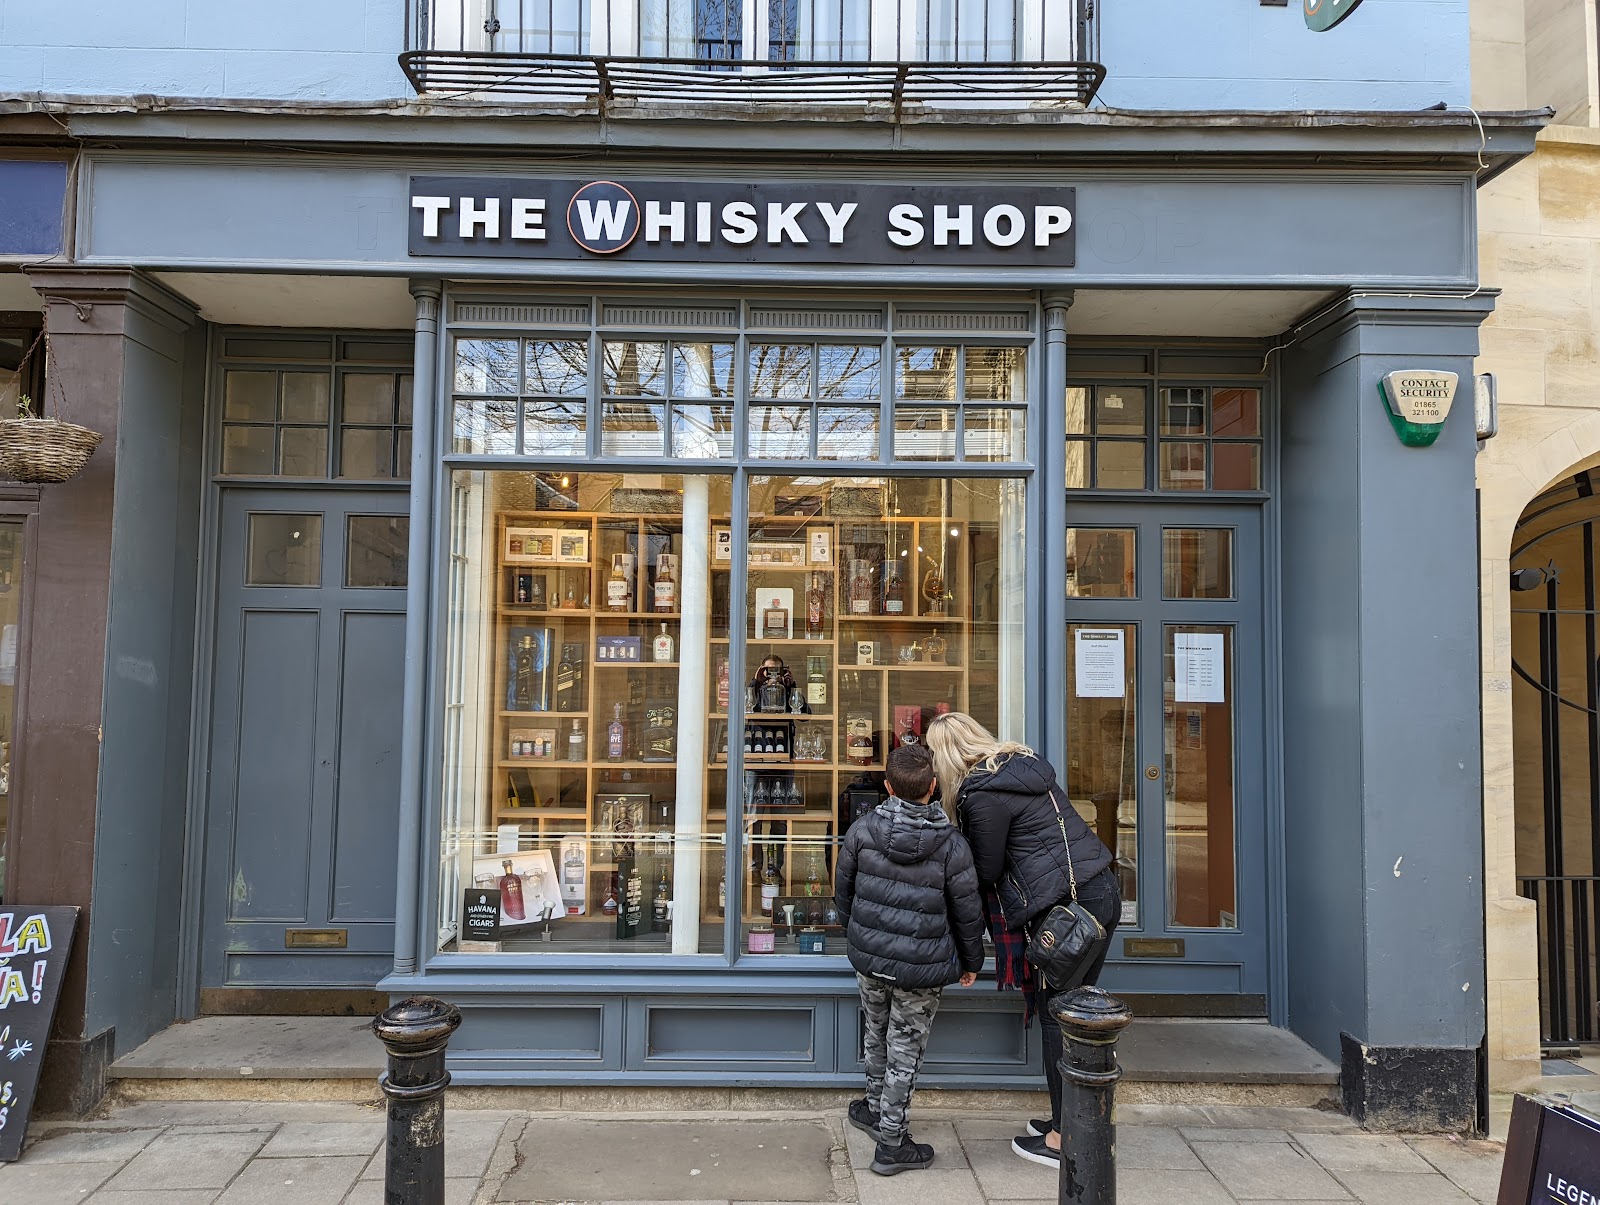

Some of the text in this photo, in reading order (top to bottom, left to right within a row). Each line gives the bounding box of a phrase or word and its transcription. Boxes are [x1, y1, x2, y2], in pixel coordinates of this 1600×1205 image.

[411, 196, 546, 239] THE
[576, 199, 858, 244] WHISKY
[886, 203, 1072, 247] SHOP
[468, 905, 497, 914] HAVANA
[469, 919, 494, 927] CIGARS
